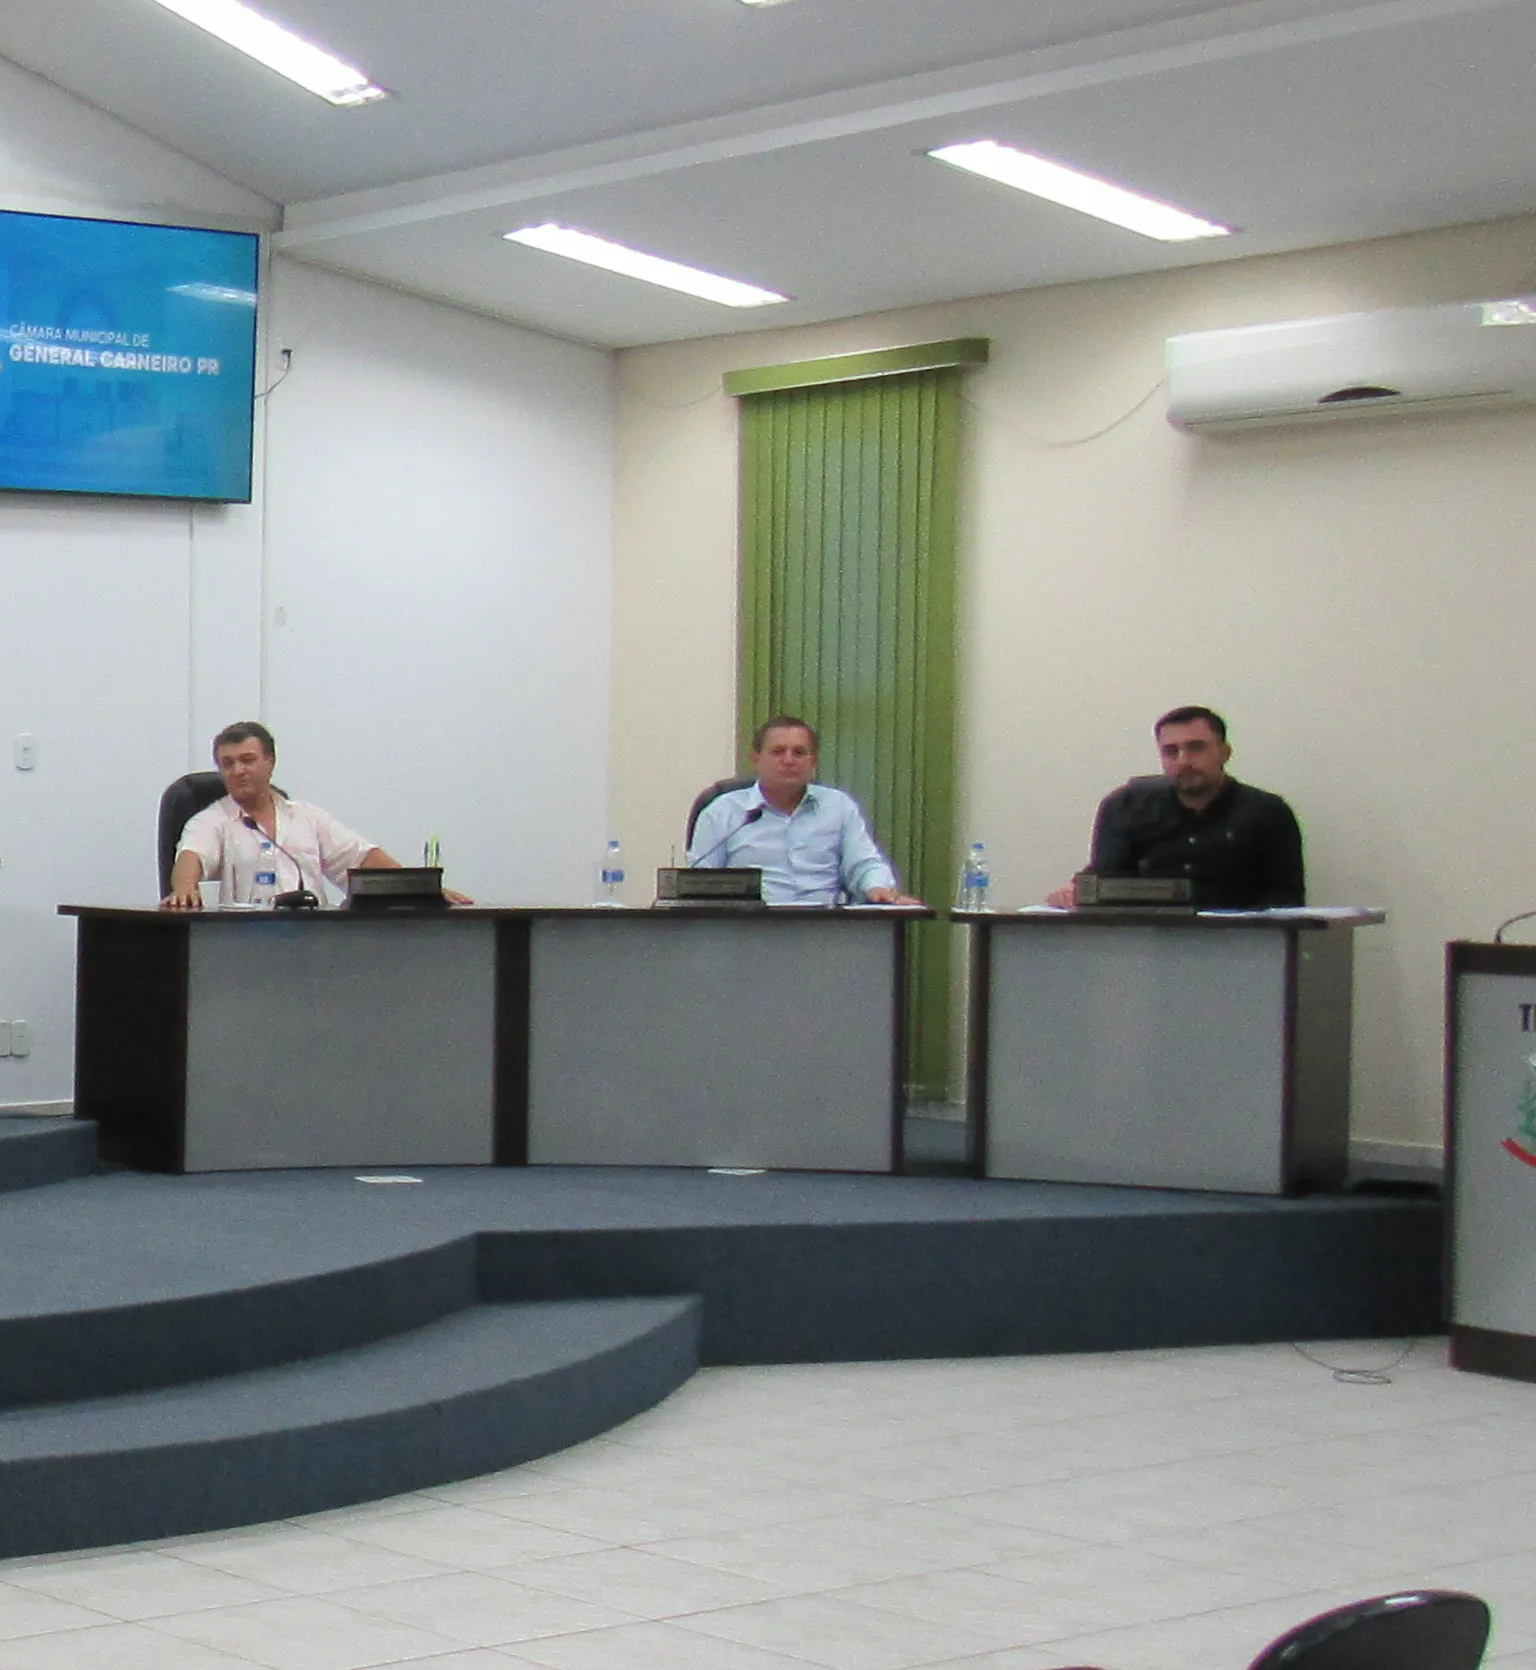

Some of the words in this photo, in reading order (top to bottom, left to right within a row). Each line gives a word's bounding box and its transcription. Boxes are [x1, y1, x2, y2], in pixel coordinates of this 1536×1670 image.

[9, 322, 61, 341] CÂMARA
[65, 329, 129, 347] MUNICIPAL
[133, 334, 150, 347] DE
[8, 344, 96, 367] GENERAL
[99, 351, 192, 374] CARNEIRO
[196, 357, 221, 375] PR
[1519, 1003, 1536, 1032] T
